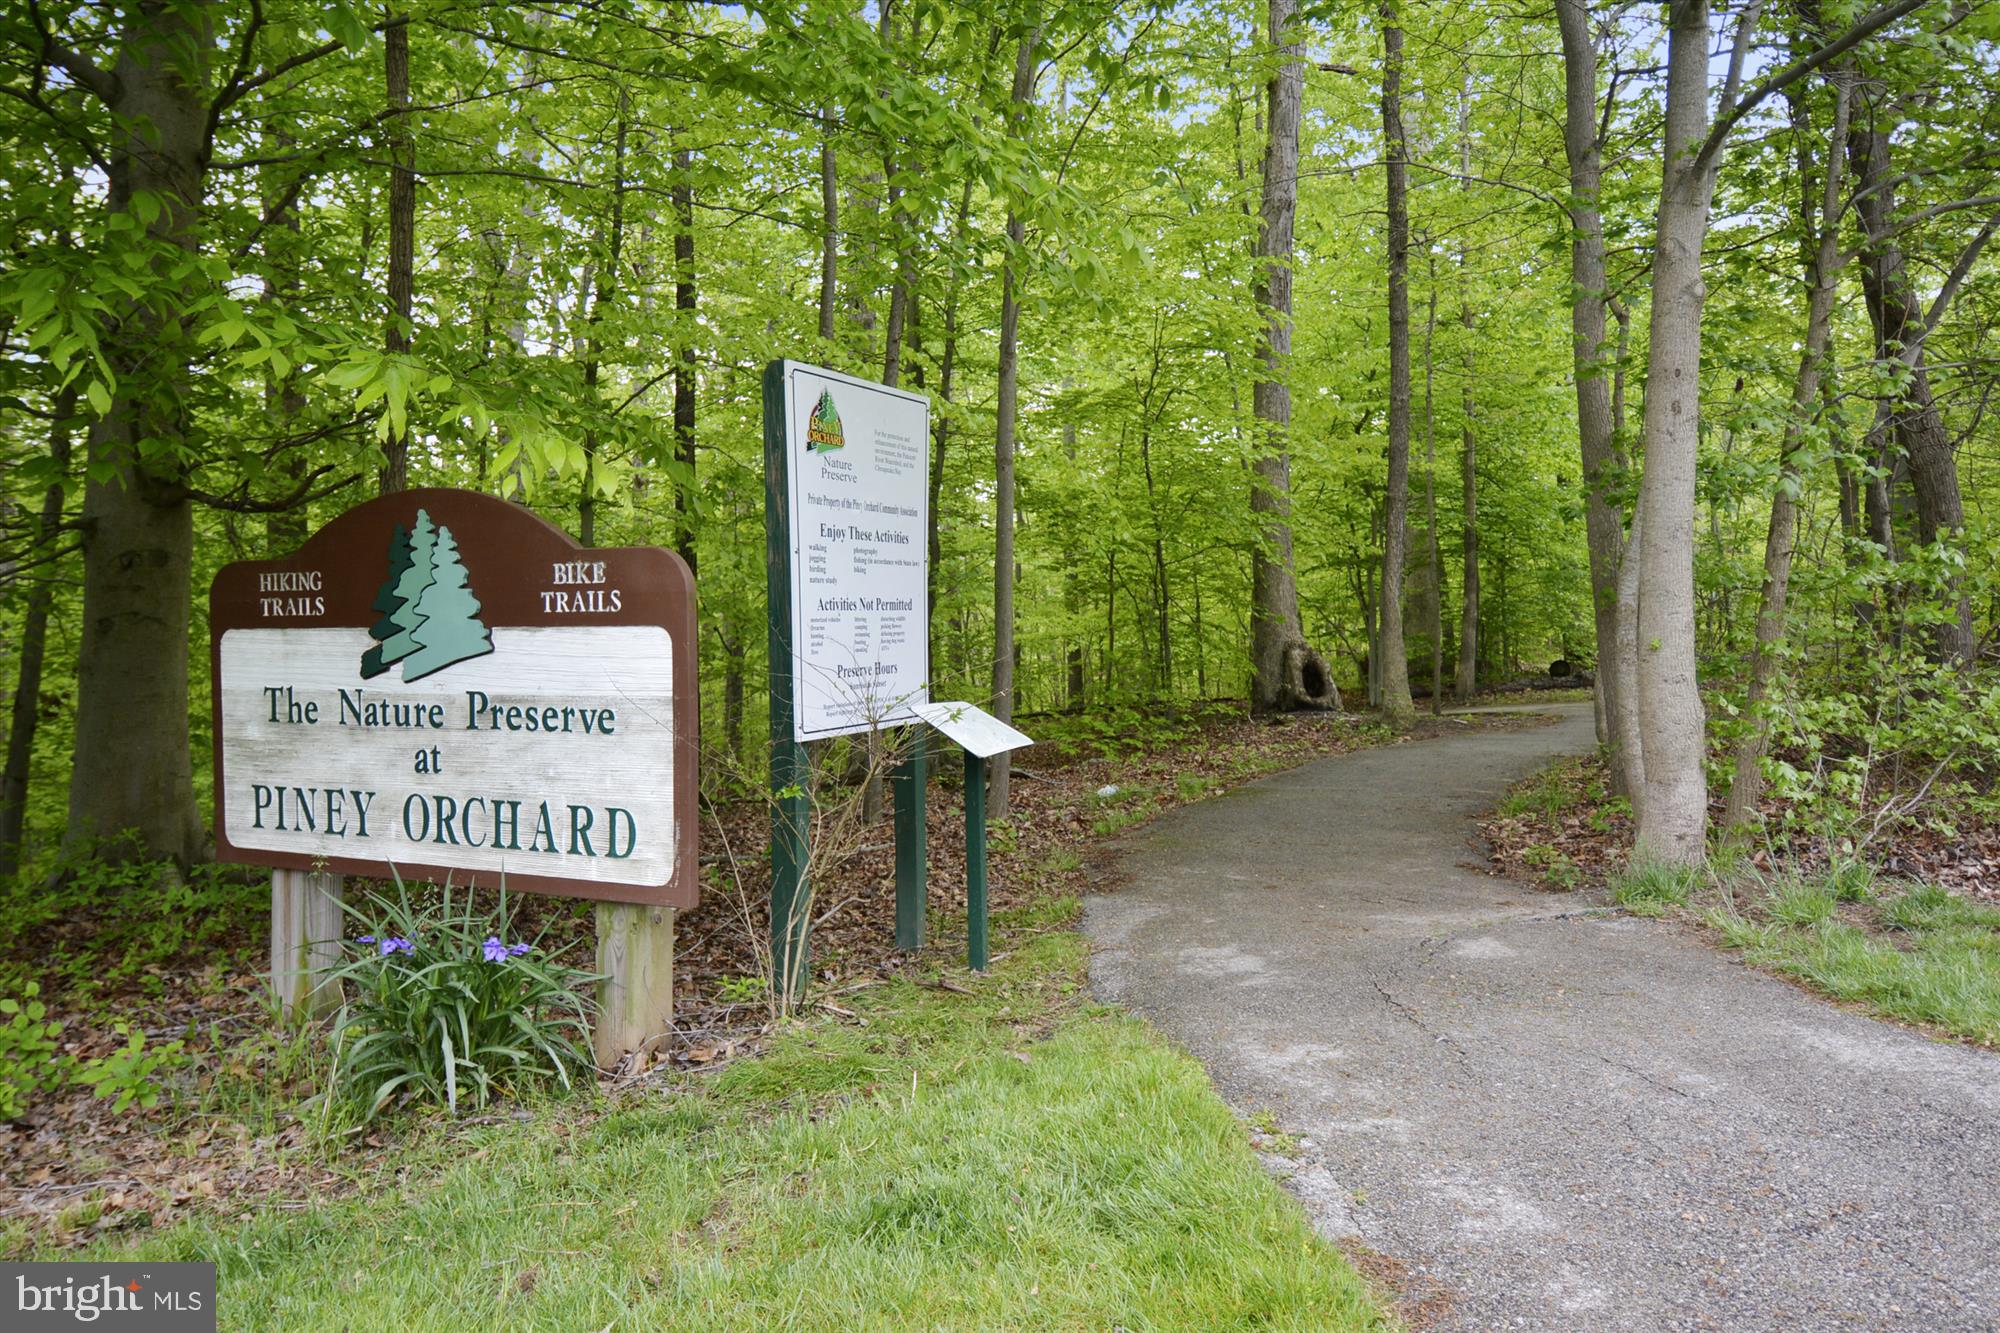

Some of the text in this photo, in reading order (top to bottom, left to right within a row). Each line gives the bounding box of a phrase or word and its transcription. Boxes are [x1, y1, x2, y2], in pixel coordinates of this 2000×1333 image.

[808, 429, 845, 448] ORCHARD
[824, 456, 852, 471] Nature
[821, 468, 858, 484] Preserve
[808, 492, 823, 506] Private
[823, 495, 841, 511] Property
[820, 523, 909, 545] Enjoy These Activities
[809, 544, 827, 553] walking
[259, 571, 323, 593] HIKING
[552, 562, 607, 586] BIKE
[260, 596, 325, 617] TRAILS
[541, 589, 622, 614] TRAILS
[817, 597, 913, 613] Activities Not Permitted
[837, 661, 898, 679] Preserve Hours
[263, 686, 616, 735] The Nature Preserve
[414, 745, 442, 774] at
[252, 784, 638, 860] PINEY ORCHARD
